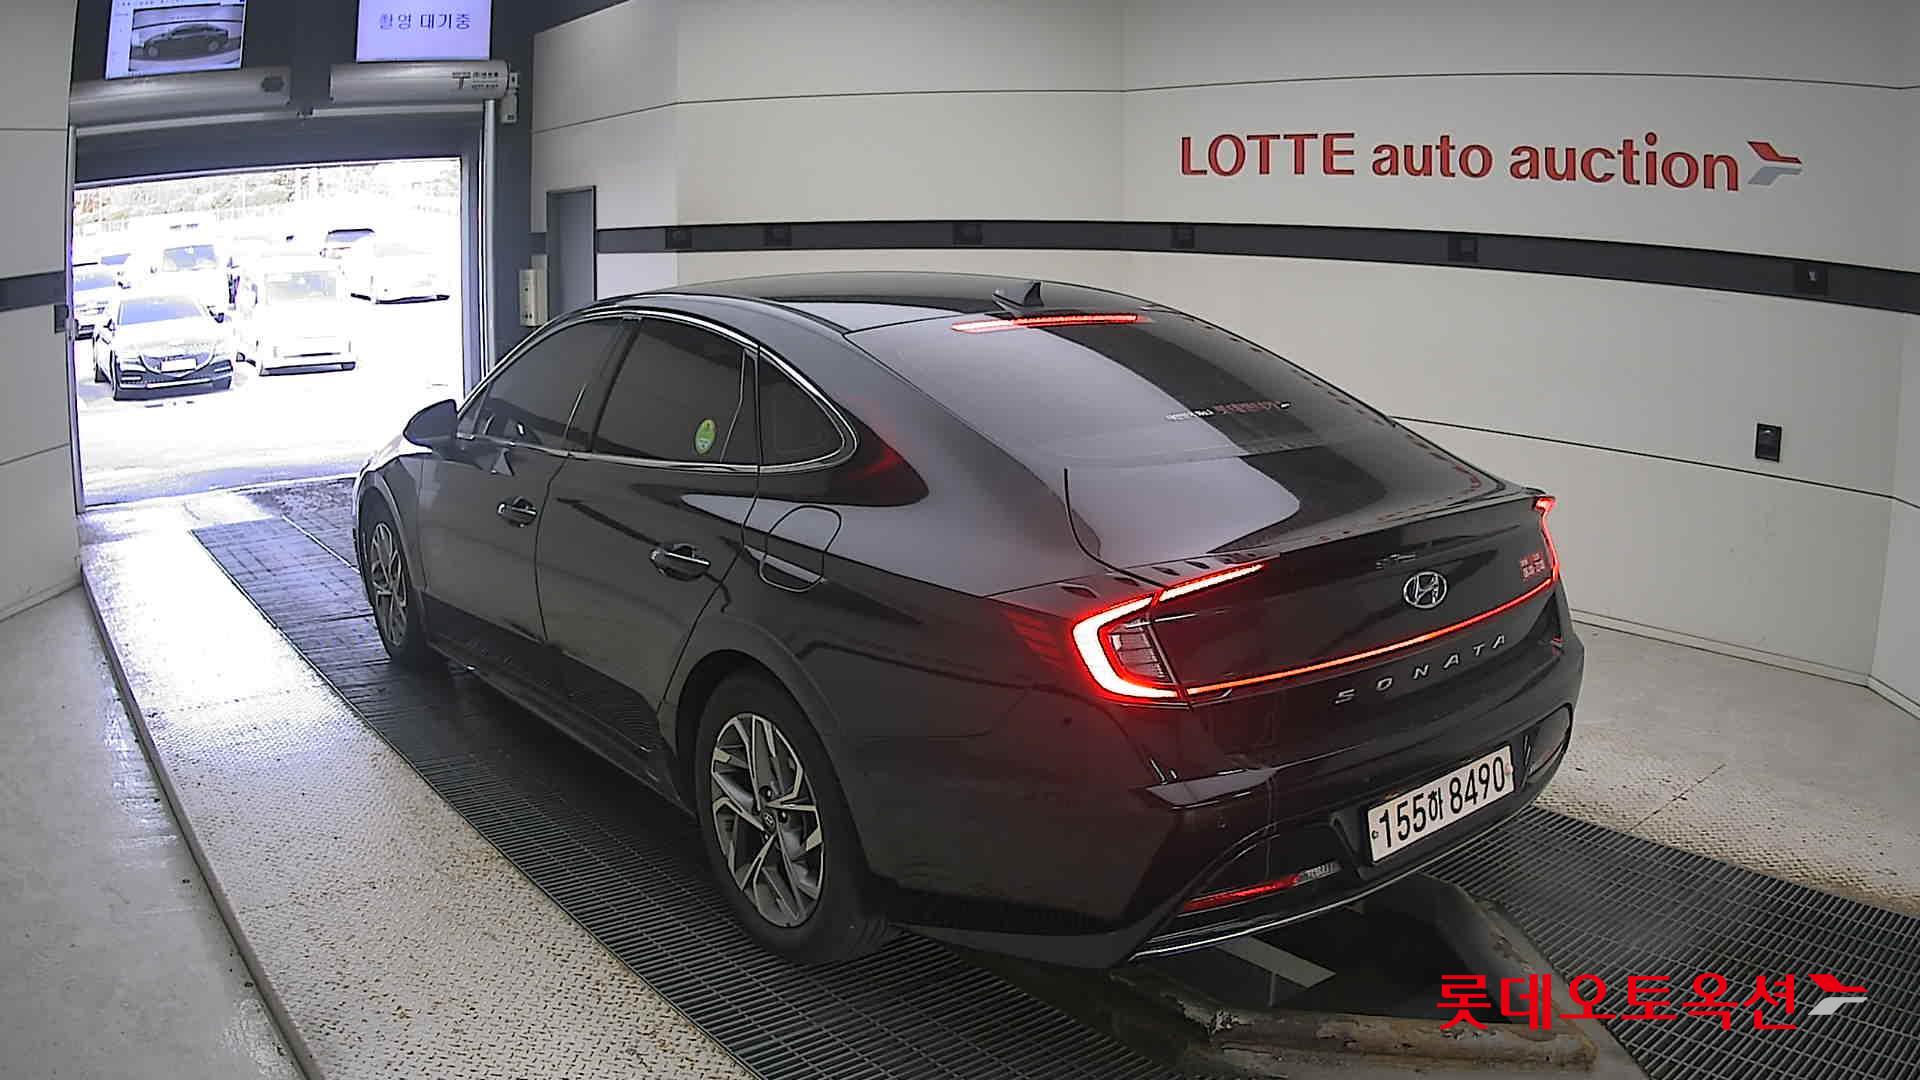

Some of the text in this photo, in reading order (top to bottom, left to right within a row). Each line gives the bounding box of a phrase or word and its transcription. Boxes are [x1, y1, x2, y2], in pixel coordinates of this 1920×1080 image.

[419, 13, 472, 30] 대기중
[1181, 132, 1740, 191] LOTTE auto auction
[1335, 634, 1505, 704] SONATA
[1379, 756, 1505, 848] 155하 8490
